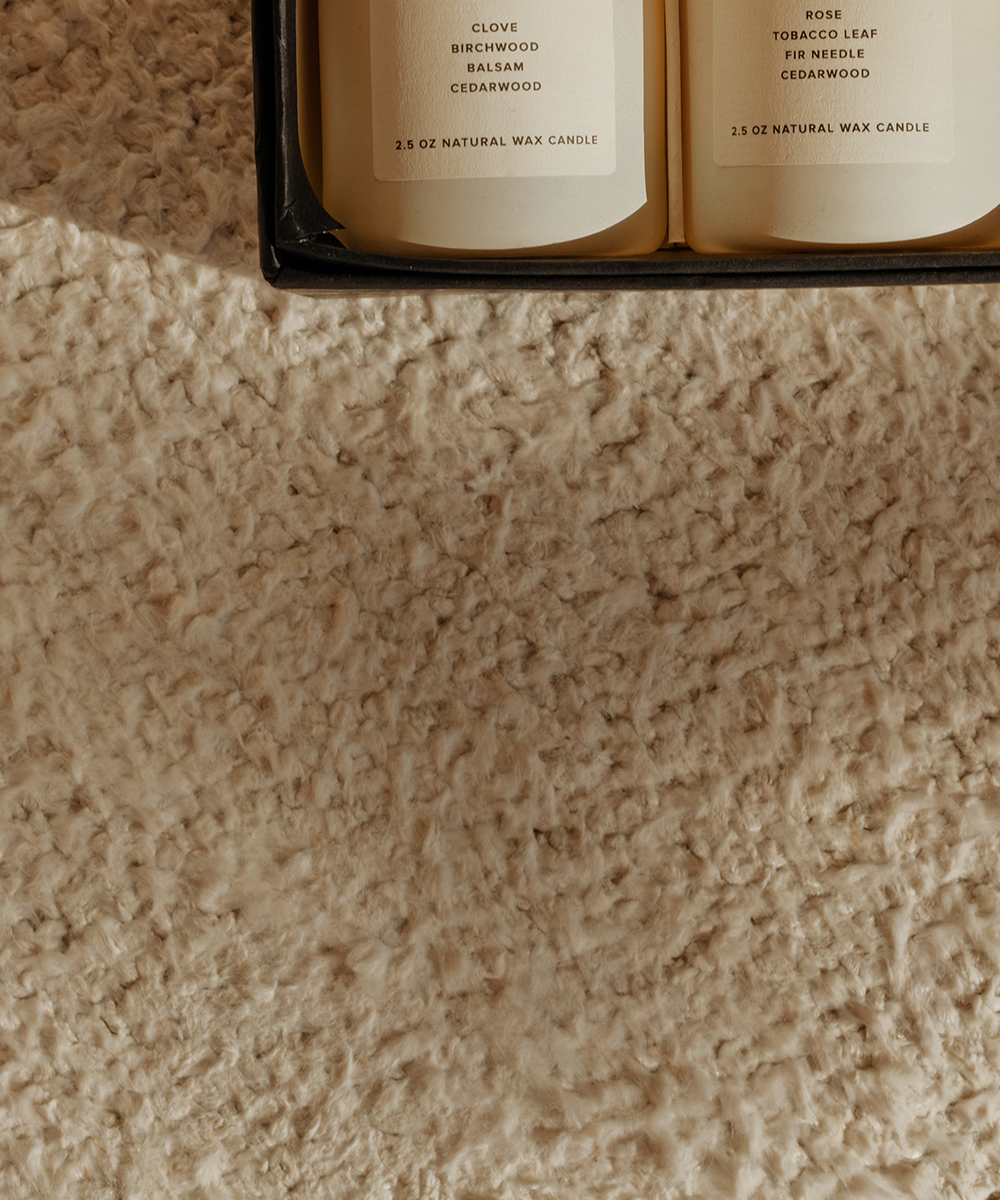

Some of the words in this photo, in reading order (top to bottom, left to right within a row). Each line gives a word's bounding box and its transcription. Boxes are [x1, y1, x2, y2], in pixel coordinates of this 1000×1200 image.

[805, 9, 842, 21] ROSE
[471, 22, 518, 34] CLOVE
[772, 29, 839, 41] TOBACCO
[843, 28, 878, 40] LEAF
[451, 41, 540, 54] BIRCHWOOD
[785, 49, 806, 61] FIR
[811, 48, 865, 60] NEEDLE
[466, 61, 524, 73] BALSAM
[780, 68, 871, 81] CEDARWOOD
[450, 81, 542, 94] CEDARWOOD
[731, 125, 748, 137] 2.5
[751, 124, 768, 136] OZ
[772, 122, 835, 135] NATURAL
[839, 122, 871, 133] WAX
[875, 122, 930, 133] CANDLE
[395, 139, 415, 151] 2.5
[418, 138, 437, 150] OZ
[441, 136, 507, 149] NATURAL
[511, 135, 543, 146] WAX
[547, 134, 598, 146] CANDLE
